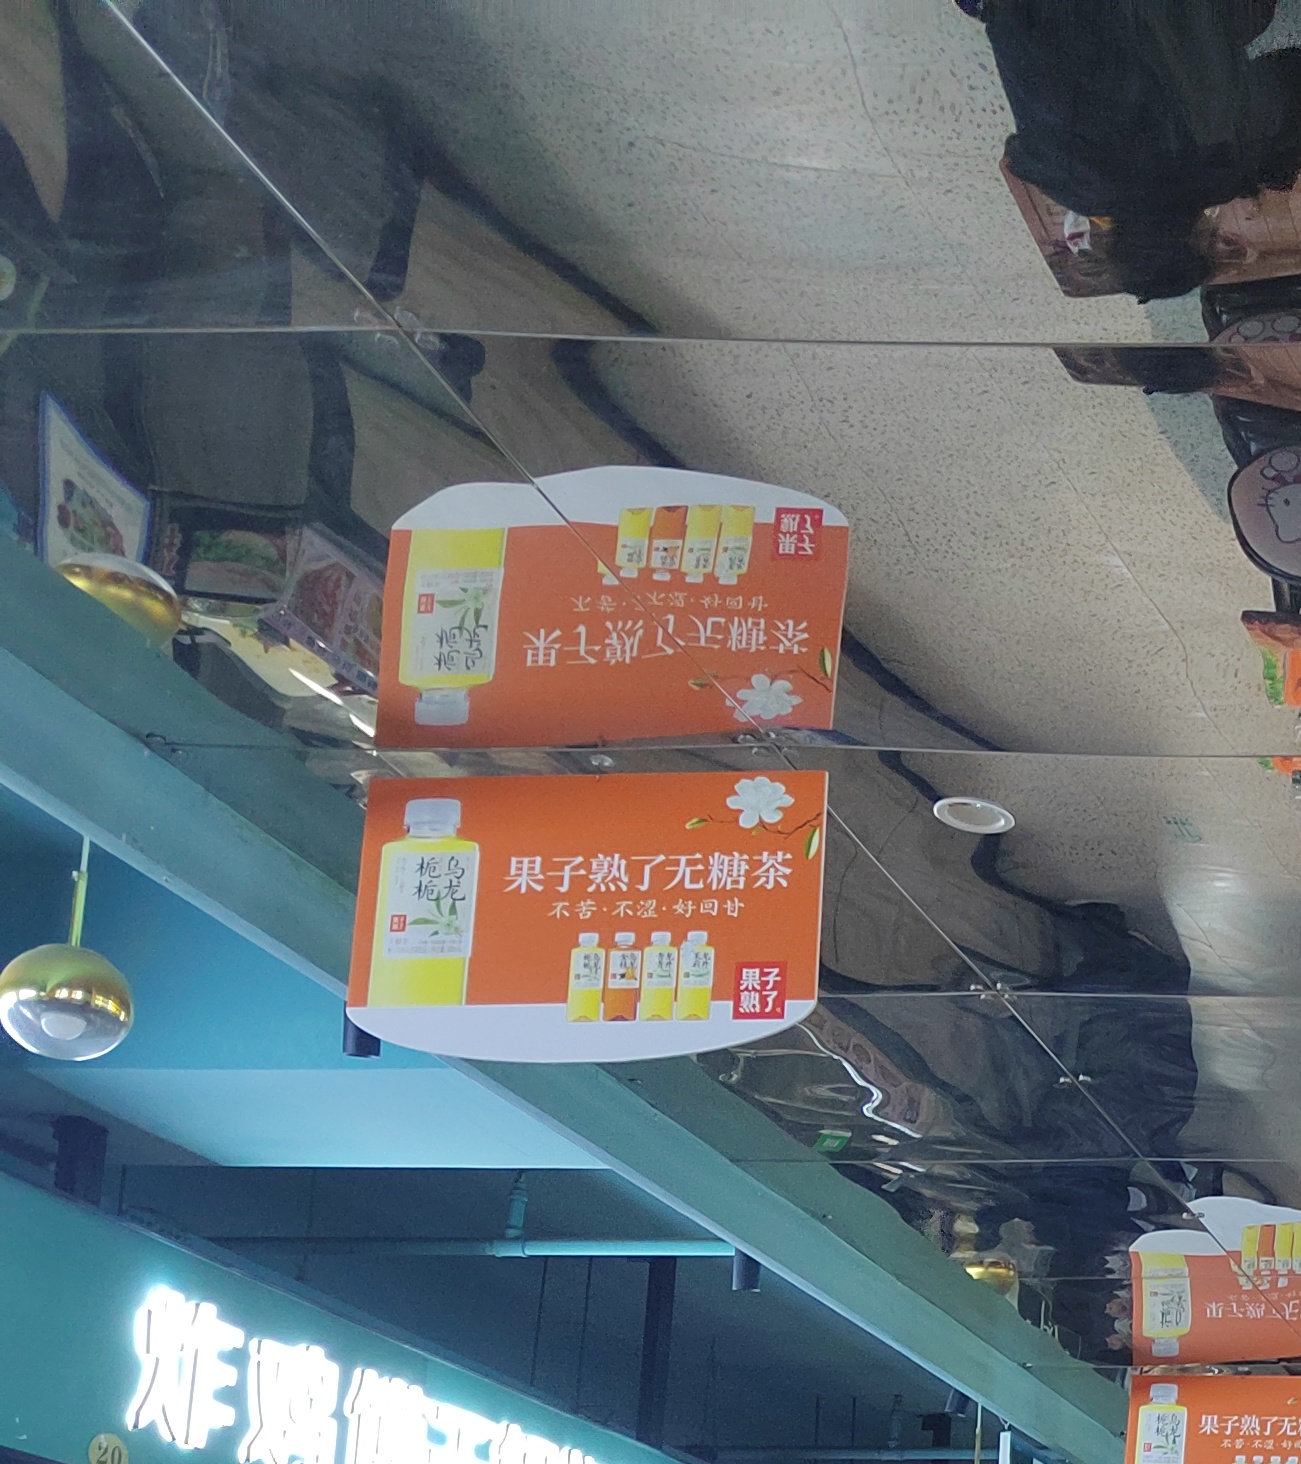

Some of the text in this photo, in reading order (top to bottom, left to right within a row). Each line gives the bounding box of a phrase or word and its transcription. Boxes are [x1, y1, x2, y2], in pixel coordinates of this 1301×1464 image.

[504, 852, 794, 894] 果子熟了无糖茶
[741, 968, 781, 990] 果子
[740, 991, 779, 1015] 熟了
